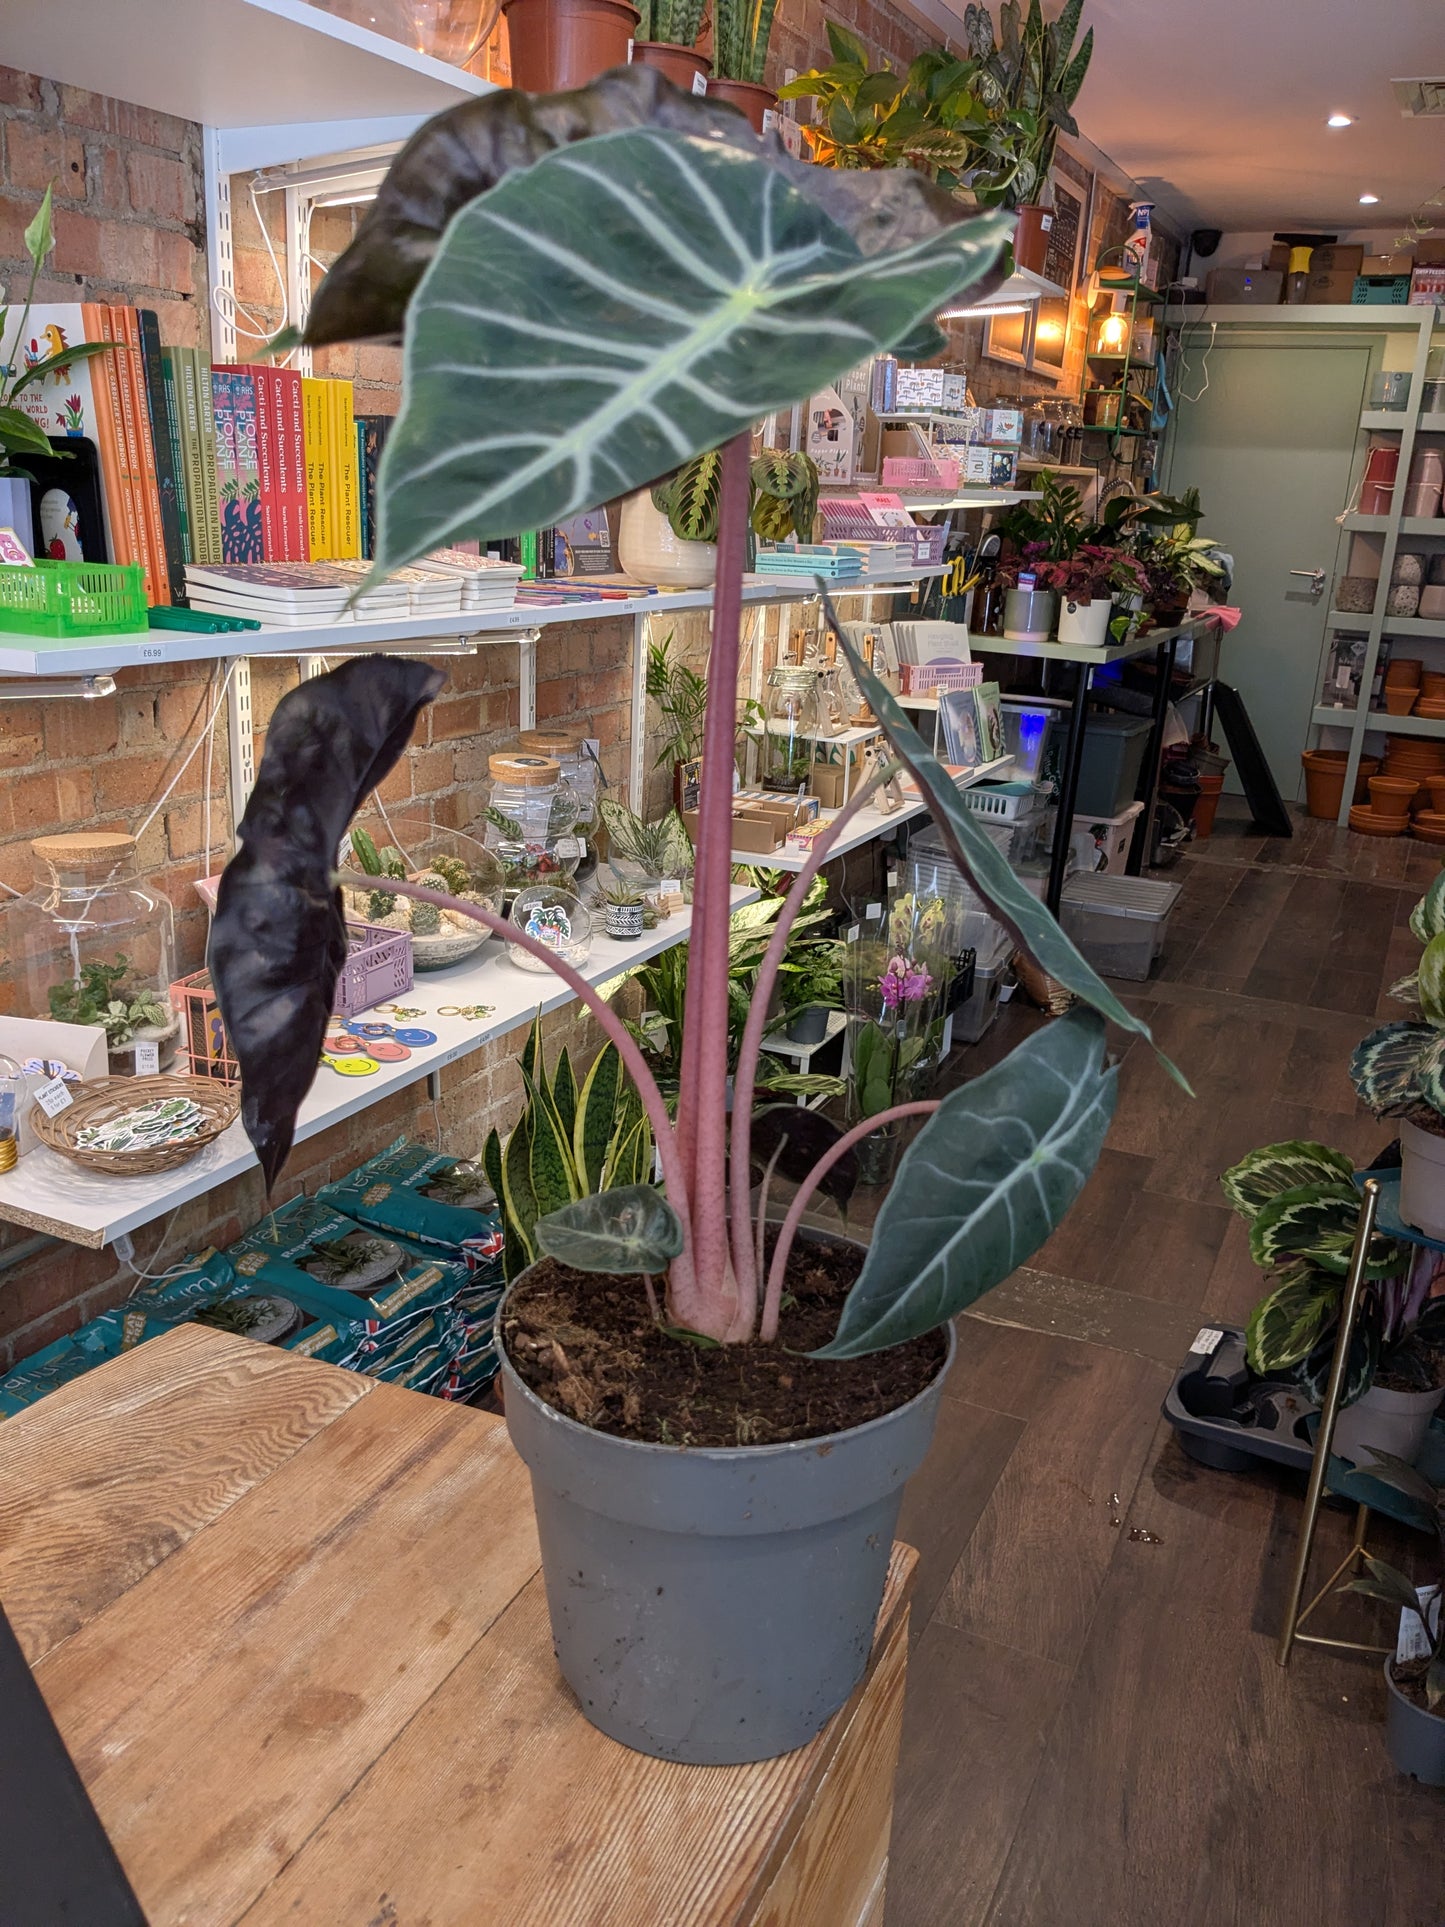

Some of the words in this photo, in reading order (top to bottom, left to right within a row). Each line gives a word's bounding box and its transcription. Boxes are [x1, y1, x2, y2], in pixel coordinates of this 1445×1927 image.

[184, 366, 194, 397] HILTON
[200, 368, 210, 398] HILTON
[218, 384, 230, 394] RHS
[242, 386, 254, 395] RHS
[258, 376, 266, 406] Cacti
[275, 378, 284, 408] Cacti
[292, 380, 300, 409] Cacti
[847, 380, 866, 392] Plants
[20, 394, 28, 402] TO
[30, 394, 43, 402] THE
[26, 405, 48, 414] WORLD
[187, 400, 197, 432] CARTER
[203, 402, 212, 432] CARTER
[260, 408, 268, 430] and
[276, 410, 284, 431] and
[294, 411, 302, 432] and
[214, 409, 227, 470] PLANT
[222, 410, 236, 470] HOUSE
[236, 410, 248, 470] PLANT
[246, 411, 258, 470] HOUSE
[262, 432, 270, 492] Succulents
[278, 434, 288, 493] Succulents
[294, 434, 304, 493] Succulents
[192, 453, 204, 523] PROPAGATION
[206, 454, 218, 524] PROPAGATION
[144, 649, 162, 657] £6.99
[281, 1222, 339, 1258] Repotting
[238, 1252, 258, 1271] PEAT
[124, 1312, 137, 1344] PEAT
[132, 1314, 147, 1343] FREE
